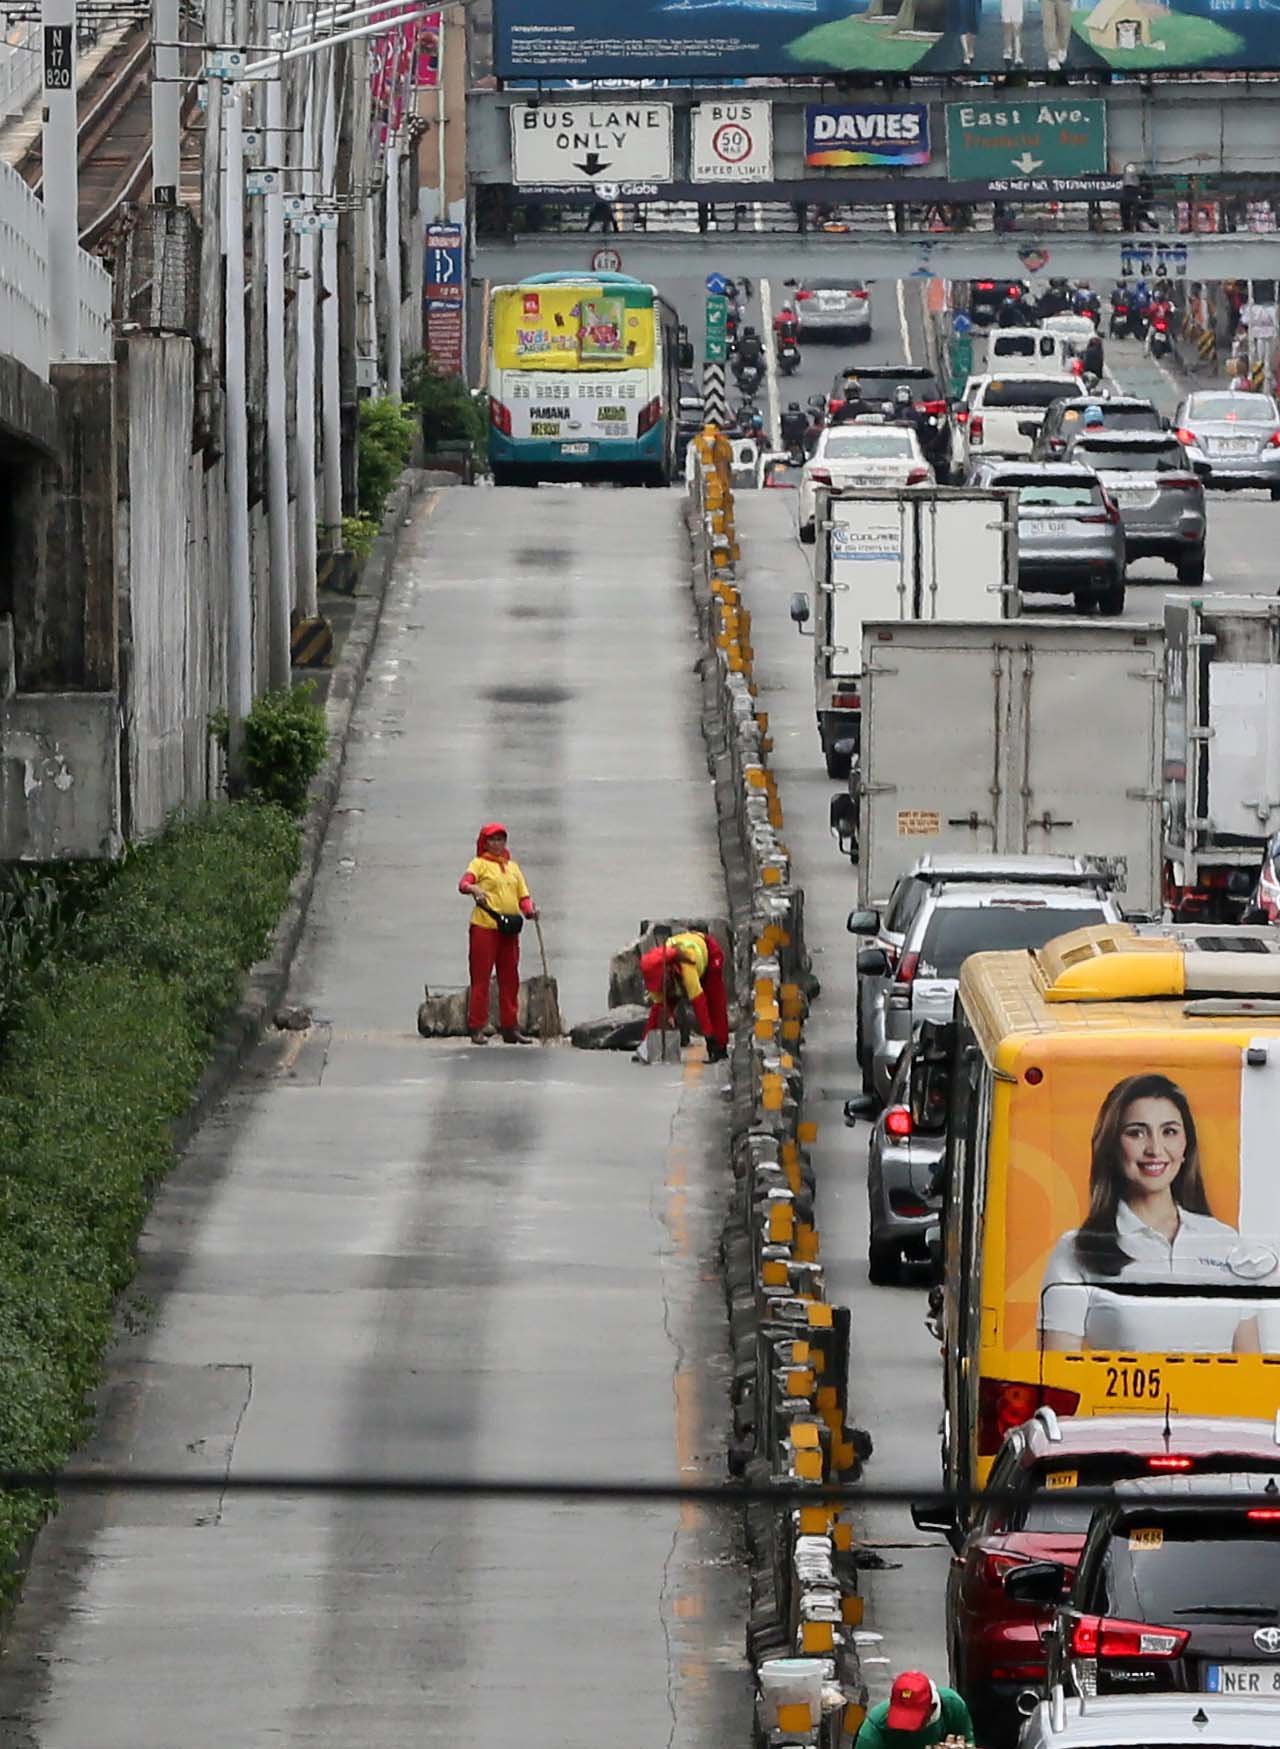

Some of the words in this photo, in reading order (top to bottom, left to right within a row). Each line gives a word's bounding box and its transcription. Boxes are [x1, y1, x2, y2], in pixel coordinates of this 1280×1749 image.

[52, 30, 63, 47] N
[51, 51, 64, 67] 17
[46, 69, 70, 86] 820
[524, 112, 574, 129] BUS
[590, 111, 660, 128] LANE
[712, 106, 752, 120] BUS
[960, 107, 1021, 128] East
[1036, 105, 1091, 126] Ave.
[813, 113, 920, 141] DAVIES
[556, 132, 627, 149] ONLY
[721, 132, 743, 146] 50
[698, 166, 734, 176] SPEED
[737, 165, 767, 176] LIMIT
[160, 188, 169, 201] N
[622, 183, 659, 196] Globe
[1106, 1368, 1161, 1399] 2105
[1225, 1672, 1260, 1691] NER
